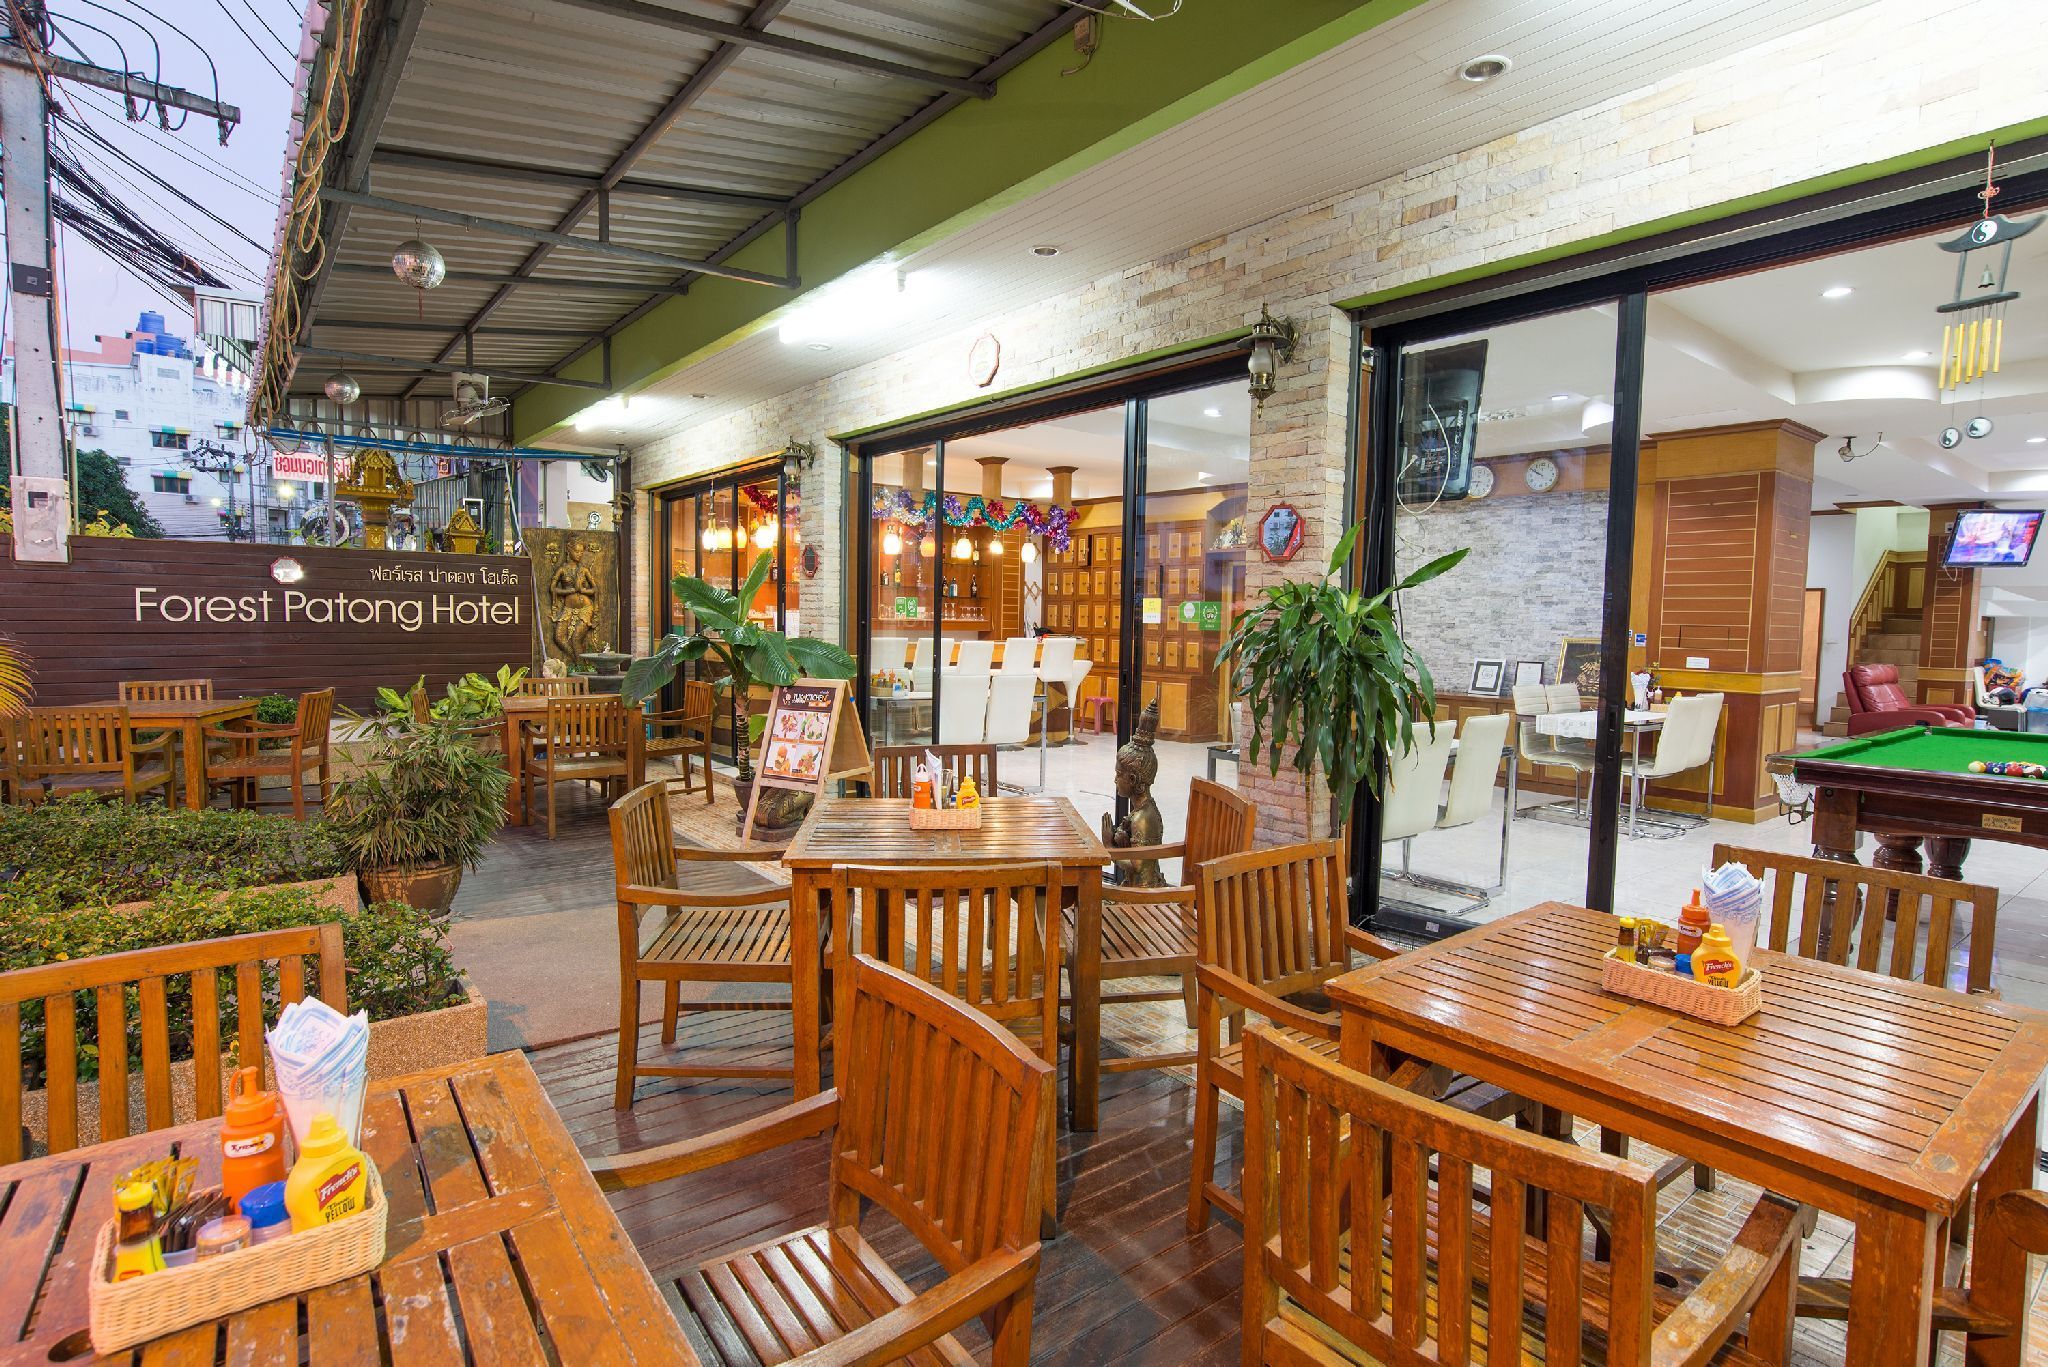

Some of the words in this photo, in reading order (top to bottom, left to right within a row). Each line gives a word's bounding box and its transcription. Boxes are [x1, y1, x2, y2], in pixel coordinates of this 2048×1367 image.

[369, 564, 423, 582] ฟอร์เรส
[428, 564, 475, 584] ป่าตอง
[479, 566, 519, 585] โฮเต็ล
[135, 587, 273, 623] Forest
[284, 590, 423, 632] Patong
[432, 594, 519, 625] Hotel
[325, 1196, 355, 1223] YELLOW
